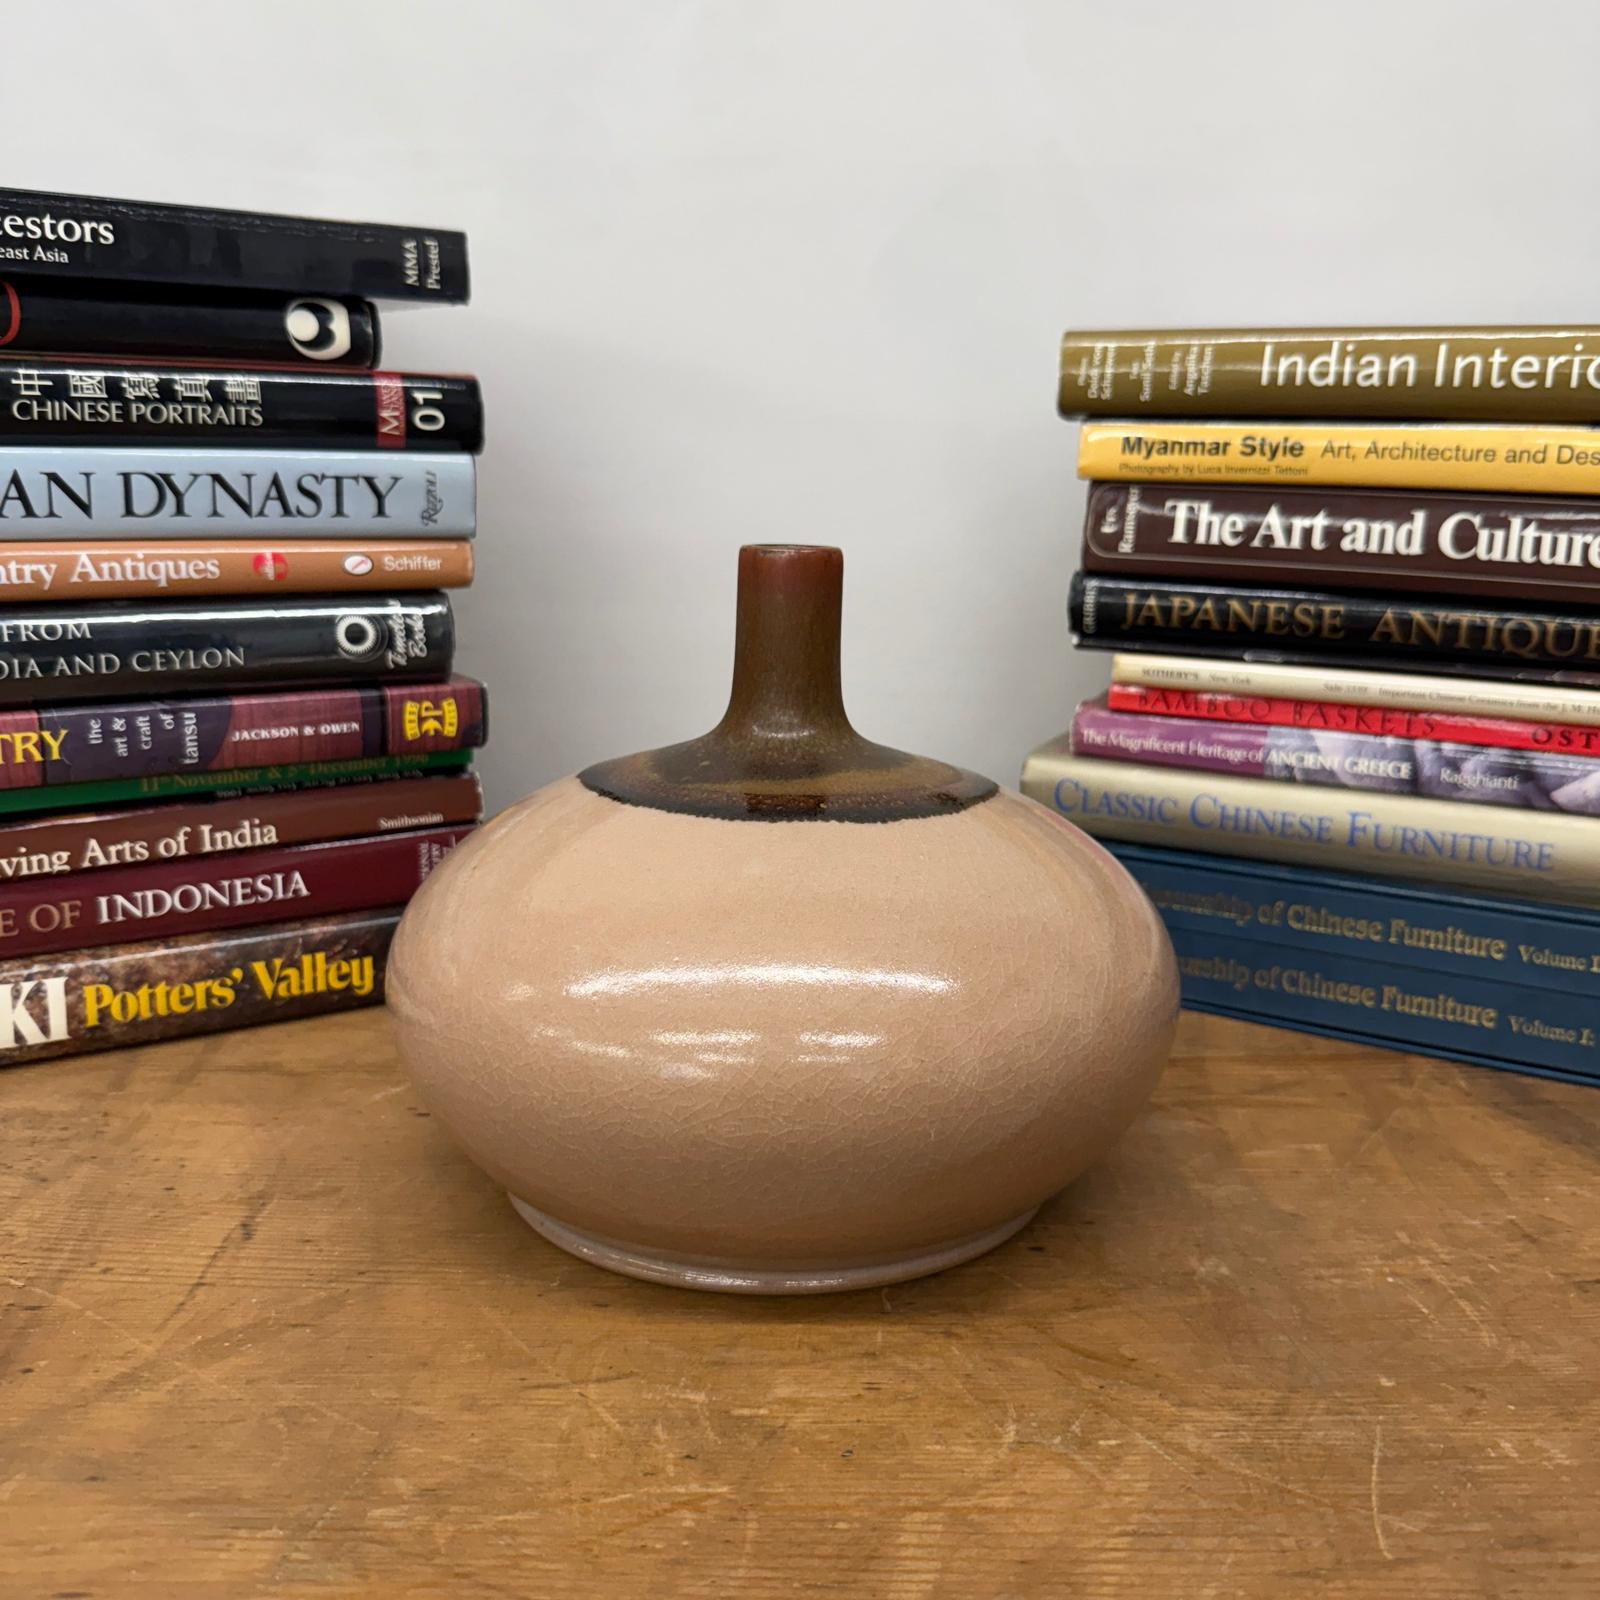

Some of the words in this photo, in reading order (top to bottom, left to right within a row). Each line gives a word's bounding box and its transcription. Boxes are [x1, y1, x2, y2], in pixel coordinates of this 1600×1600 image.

[0, 213, 115, 245] estors
[33, 244, 69, 263] Asia
[403, 239, 420, 287] MMA
[1259, 341, 1417, 388] Indian
[12, 399, 124, 423] CHINESE
[131, 402, 263, 427] PORTRAITS
[412, 391, 446, 431] 01
[1121, 436, 1231, 460] Myanmar
[1239, 436, 1304, 461] Style
[1321, 440, 1356, 461] Art,
[1364, 441, 1496, 463] Architecture
[1505, 445, 1548, 465] and
[0, 469, 95, 519] AN
[118, 470, 402, 519] DYNASTY
[1165, 498, 1244, 550] The
[1253, 503, 1331, 551] Art
[1341, 508, 1427, 556] and
[1438, 511, 1600, 570] Culture
[70, 550, 220, 587] Antiques
[384, 555, 442, 572] Schiffer
[2, 622, 93, 642] FROM
[1120, 592, 1345, 641] JAPANESE
[1368, 608, 1600, 661] ANTIQUE
[54, 652, 121, 677] AND
[131, 646, 245, 673] CEYLON
[88, 718, 103, 745] the
[112, 716, 127, 732] &
[160, 713, 174, 730] of
[232, 727, 299, 742] JACKSON
[304, 723, 316, 736] &
[319, 721, 360, 737] OWEN
[1138, 692, 1271, 719] BAMBOO
[1292, 702, 1436, 735] BASKETS
[114, 736, 128, 757] art
[136, 714, 152, 750] craft
[183, 711, 199, 764] tansu
[1083, 729, 1106, 746] The
[1109, 732, 1187, 755] Magnificent
[1189, 739, 1248, 765] Heritage
[1249, 746, 1265, 763] of
[1268, 749, 1338, 771] ANCIENT
[1345, 757, 1413, 780] GREECE
[175, 768, 259, 788] November
[267, 765, 282, 779] &
[1440, 766, 1519, 790] Ragghianti
[379, 813, 444, 830] Smithsonian
[1054, 777, 1178, 825] CLASSIC
[1188, 792, 1334, 843] CHINESE
[1346, 810, 1556, 872] FURNITURE
[0, 846, 71, 877] ving
[80, 838, 149, 868] Arts
[158, 826, 192, 857] of
[199, 818, 279, 852] India
[28, 900, 82, 933] OF
[96, 870, 311, 924] INDONESIA
[1257, 900, 1286, 926] of
[1287, 903, 1383, 943] Chinese
[1388, 918, 1507, 961] Furniture
[1518, 944, 1586, 972] Volume
[0, 976, 72, 1049] KI
[83, 966, 243, 1029] Potters'
[253, 950, 375, 1001] Valley
[1253, 965, 1281, 990] of
[1281, 968, 1377, 1008] Chinese
[1381, 984, 1498, 1030] Furniture
[1508, 1014, 1577, 1042] Volume
